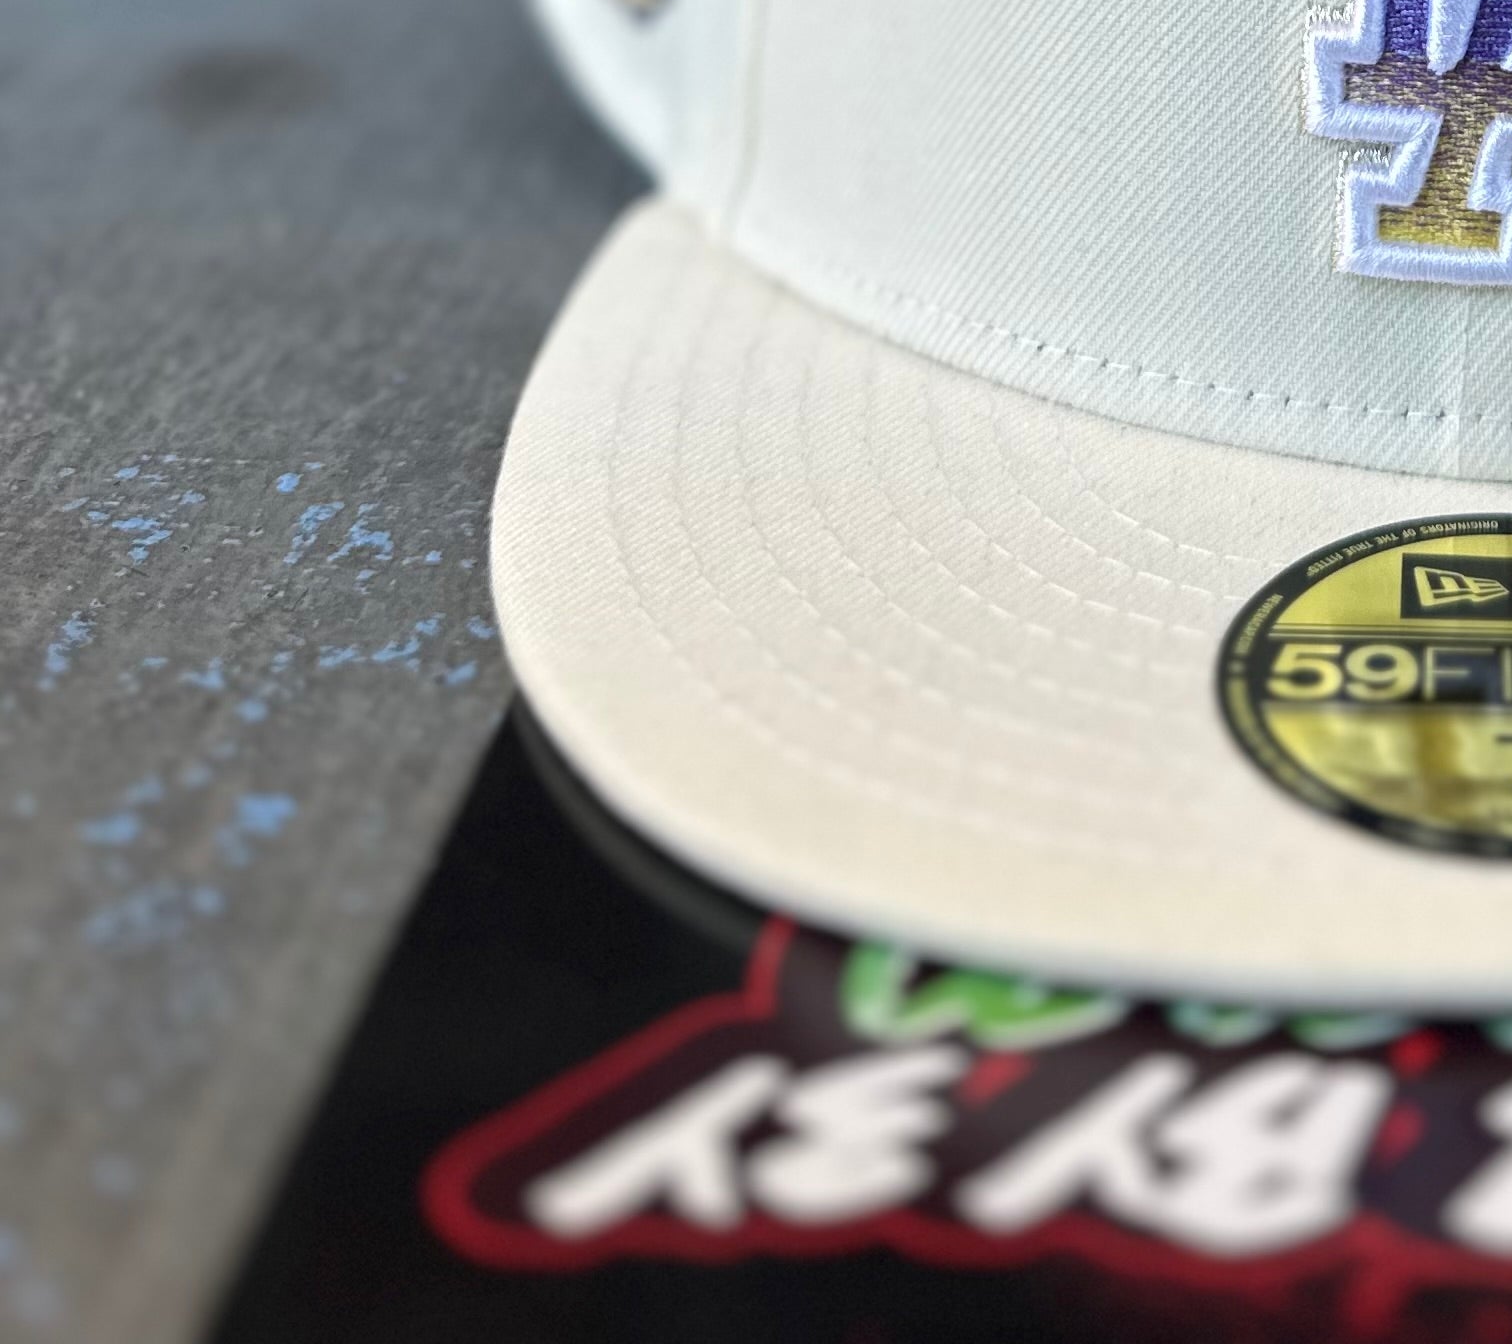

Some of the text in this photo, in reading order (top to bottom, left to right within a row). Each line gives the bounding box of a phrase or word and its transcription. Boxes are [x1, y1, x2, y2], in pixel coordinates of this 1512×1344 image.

[1401, 527, 1417, 538] OF
[1419, 519, 1499, 535] ORIGINATORS
[1376, 531, 1400, 545] THE
[1348, 540, 1374, 556] TRUE
[955, 1052, 1393, 1255] BY
